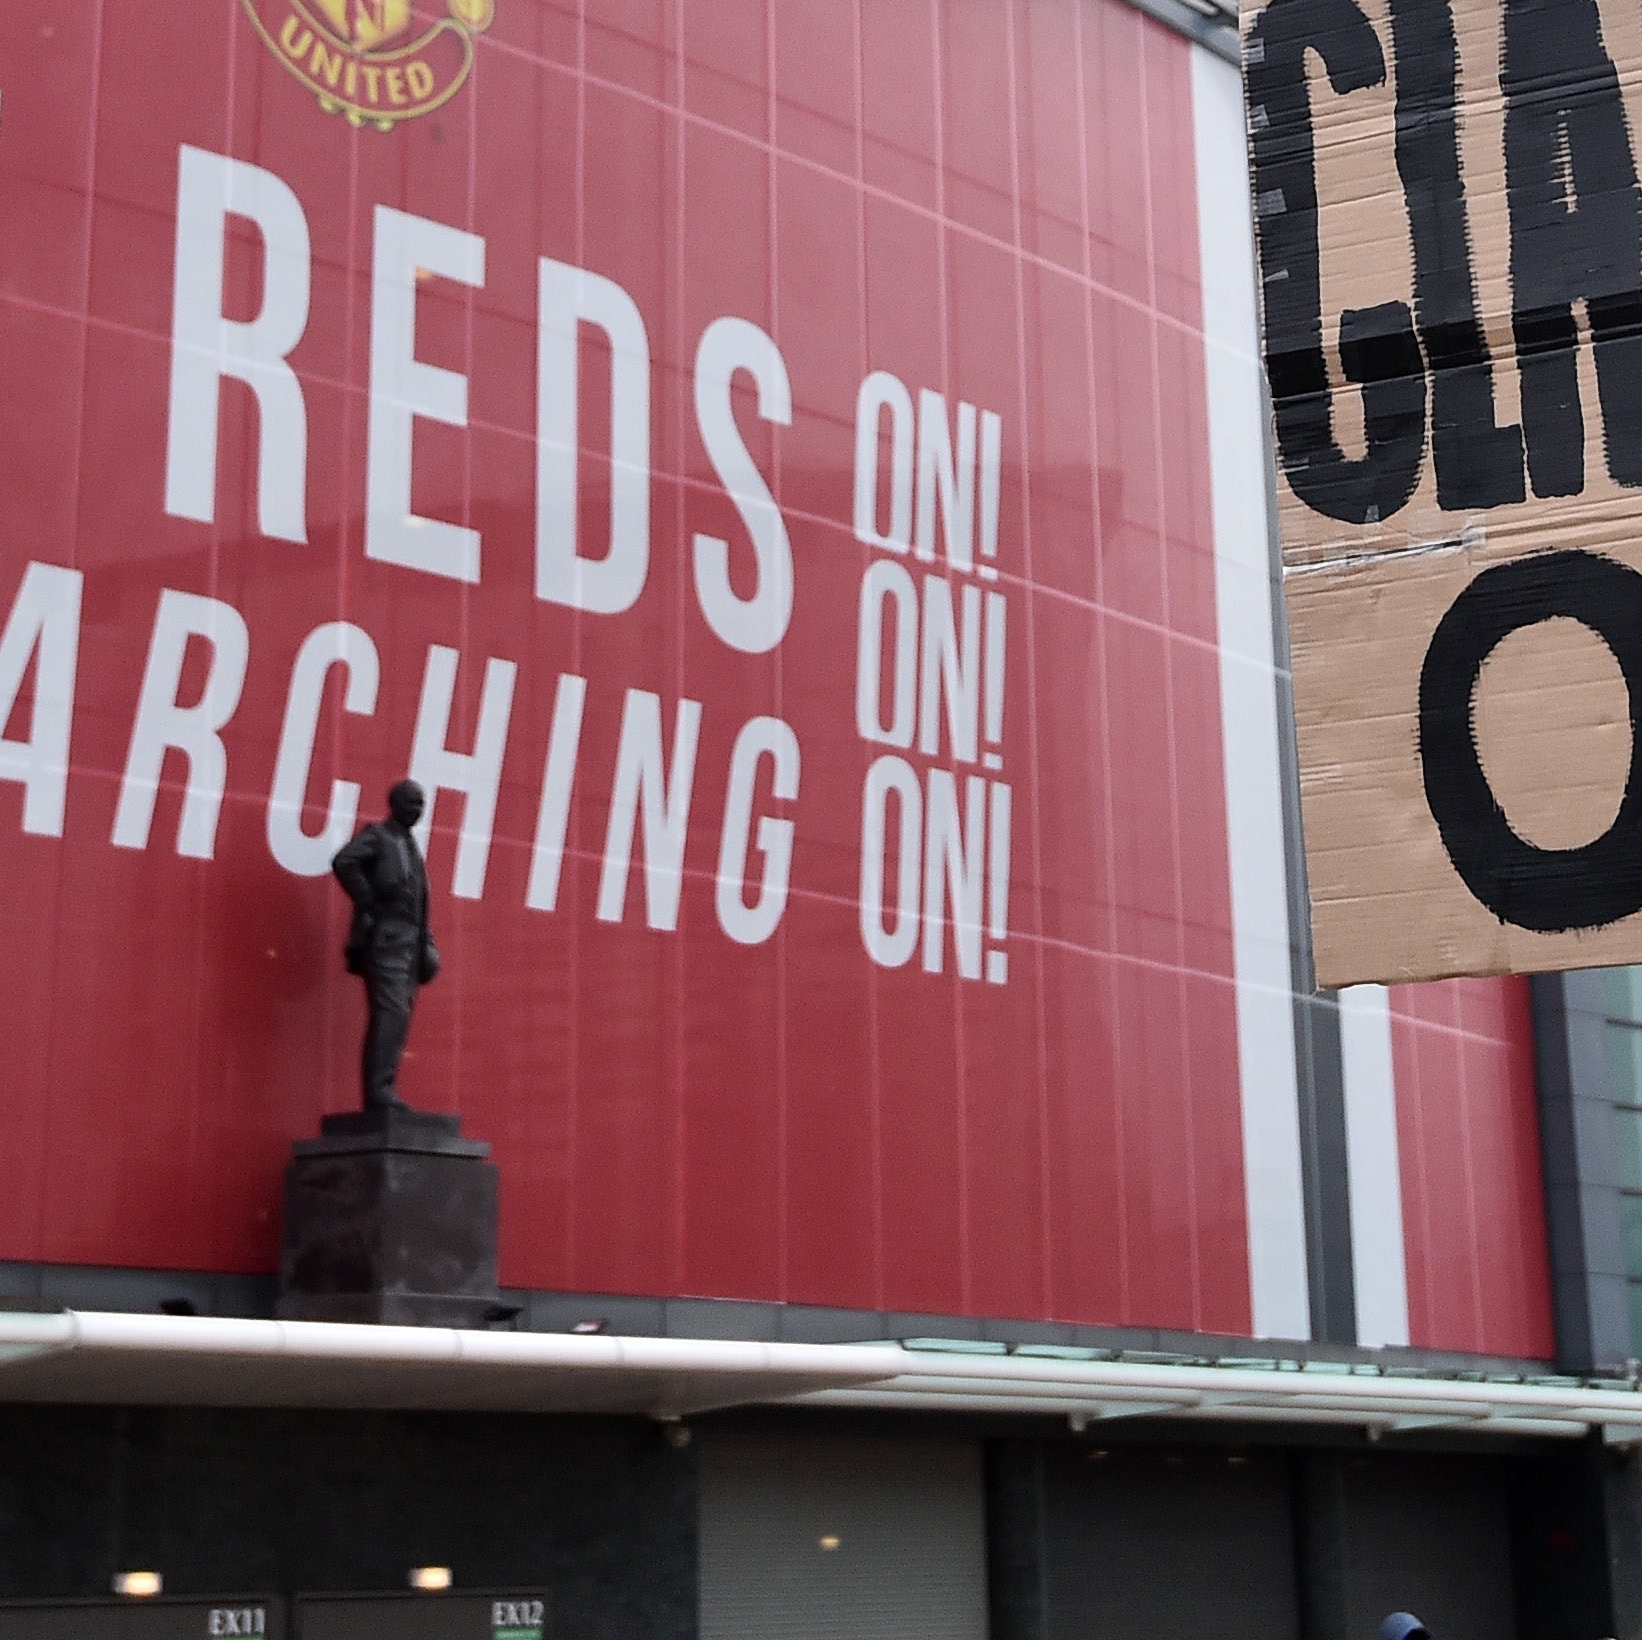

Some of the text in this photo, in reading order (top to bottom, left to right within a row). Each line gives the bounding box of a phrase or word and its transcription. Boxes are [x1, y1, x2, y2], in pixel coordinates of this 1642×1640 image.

[279, 14, 436, 105] UNITED
[164, 143, 794, 654] REDS
[854, 370, 1002, 580] ON!
[856, 559, 1008, 770] ON!
[858, 755, 1013, 986] ON!
